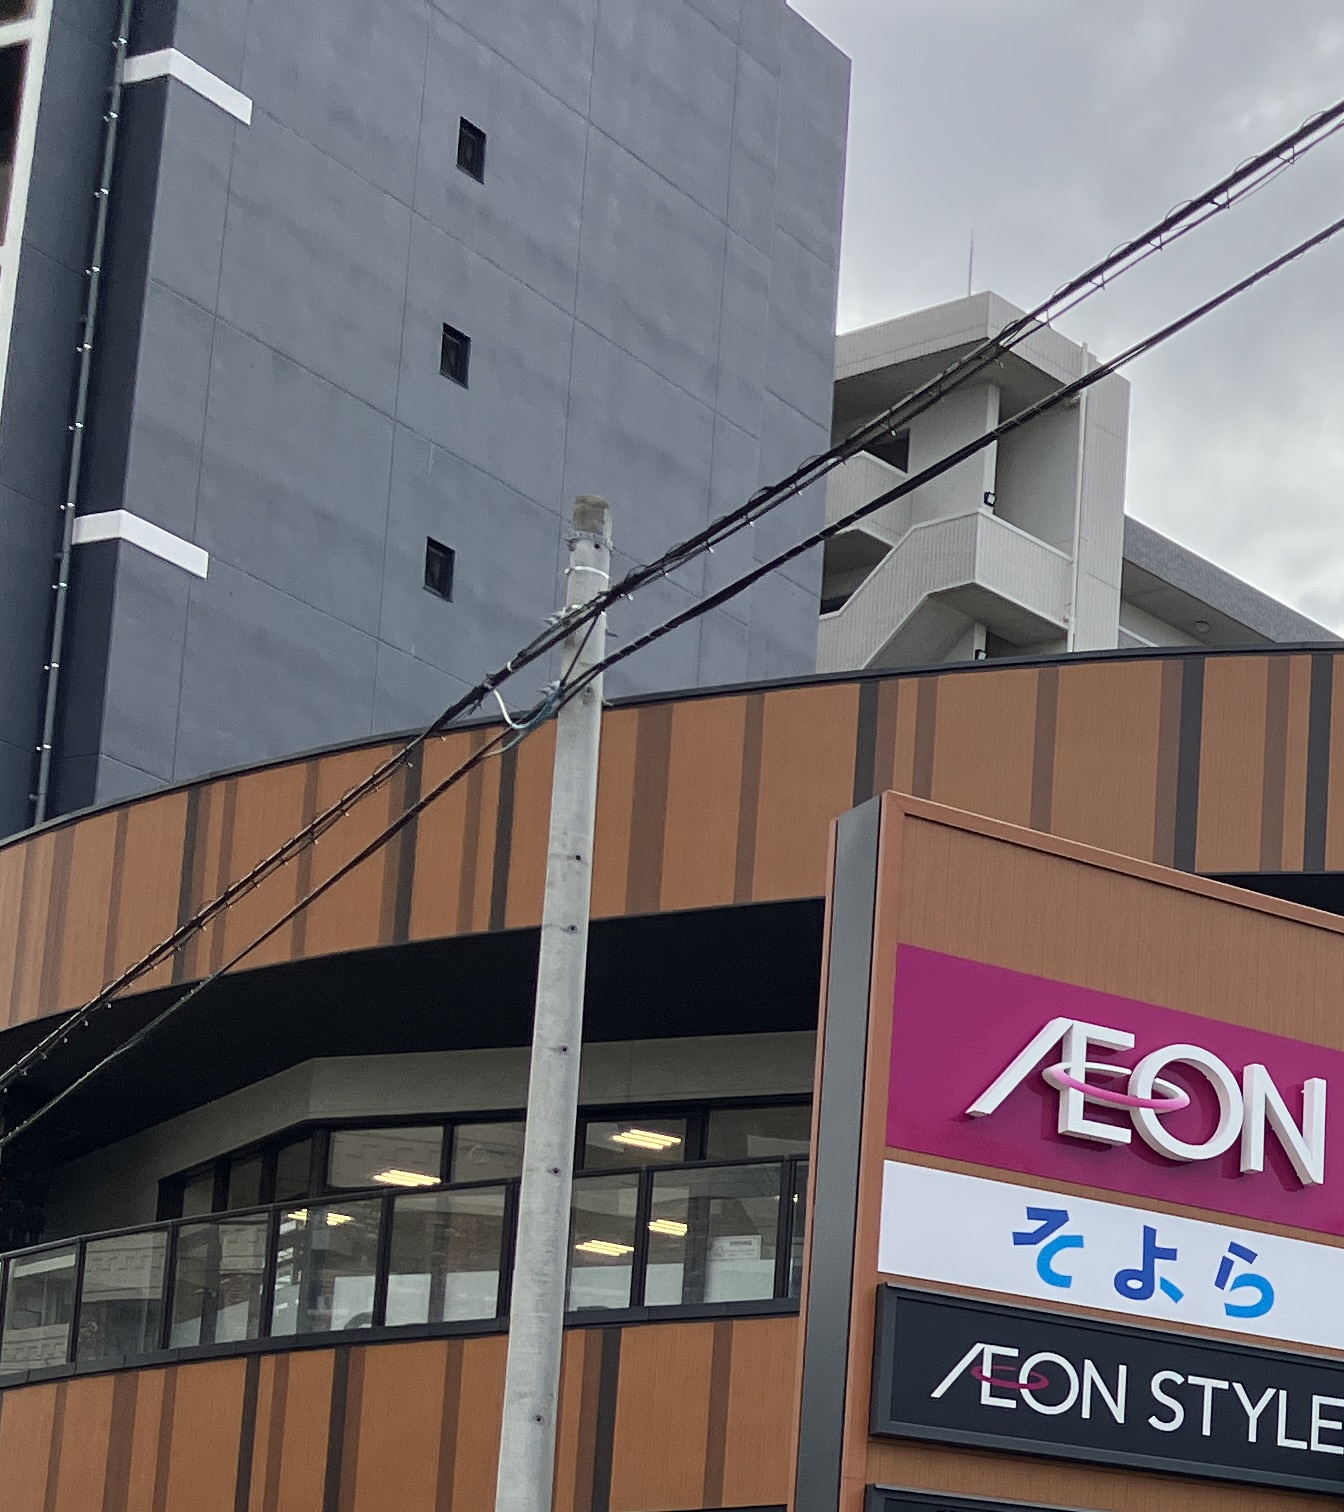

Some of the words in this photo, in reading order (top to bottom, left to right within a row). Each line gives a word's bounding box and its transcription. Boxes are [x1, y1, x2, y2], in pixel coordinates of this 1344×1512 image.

[1012, 1206, 1275, 1319] そよら
[1148, 1370, 1344, 1455] STYLE
